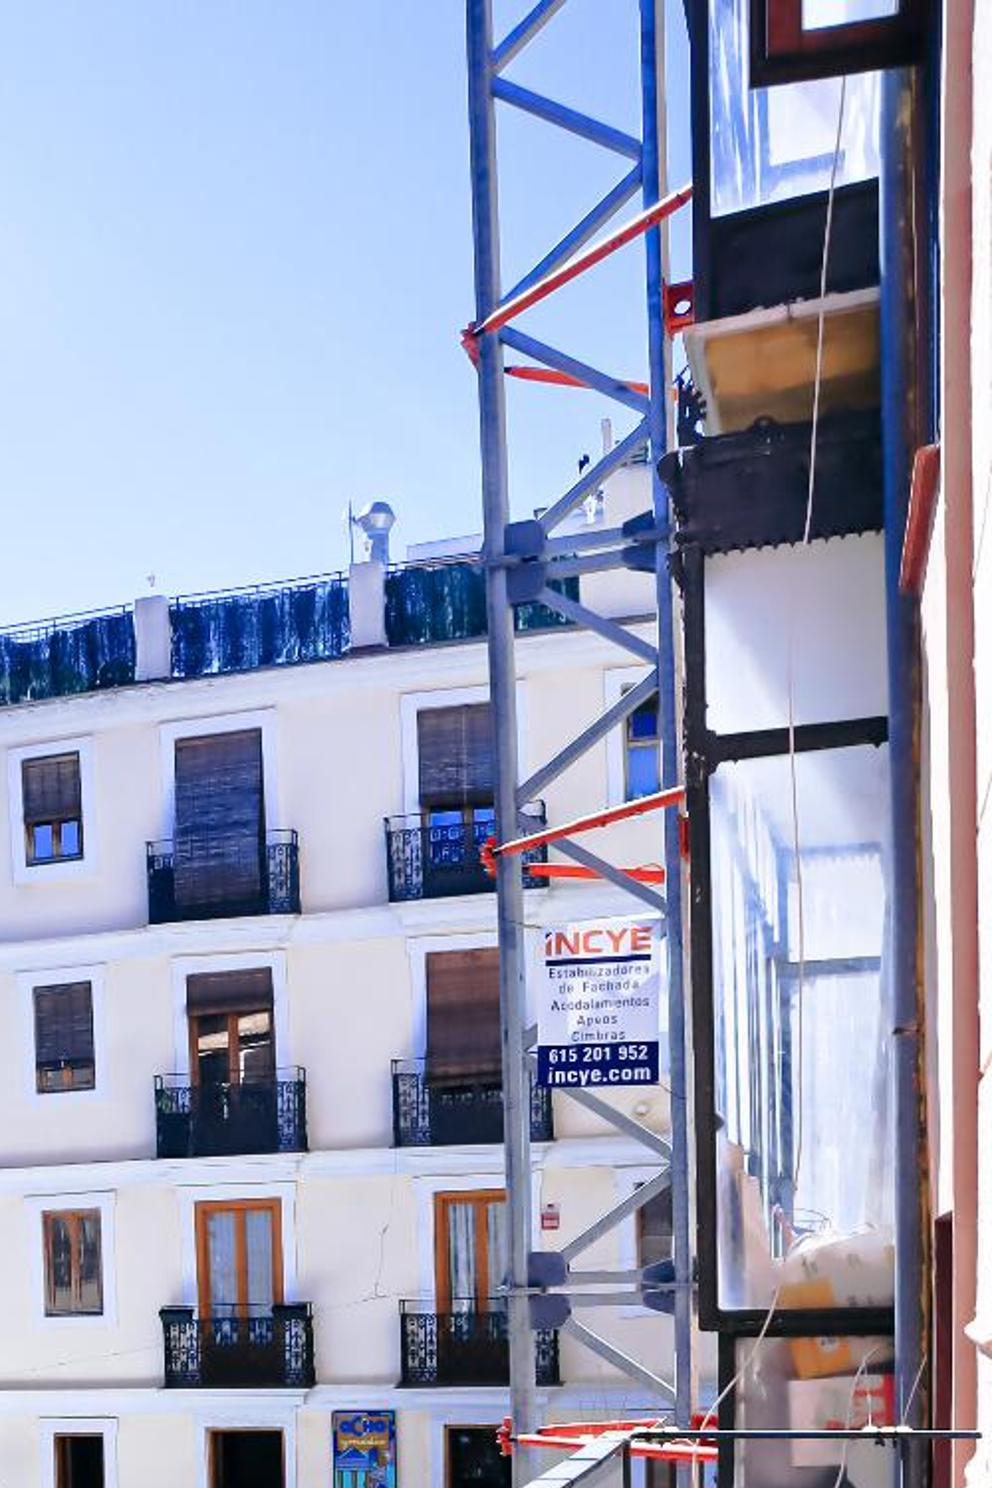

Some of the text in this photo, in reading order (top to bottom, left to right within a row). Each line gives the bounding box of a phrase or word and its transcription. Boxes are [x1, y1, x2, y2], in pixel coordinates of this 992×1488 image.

[559, 980, 640, 994] de Fachada
[577, 1014, 618, 1026] Apeos
[571, 1030, 626, 1042] Cimbras
[549, 1045, 648, 1064] 615 201 952
[548, 1066, 651, 1085] incye.com
